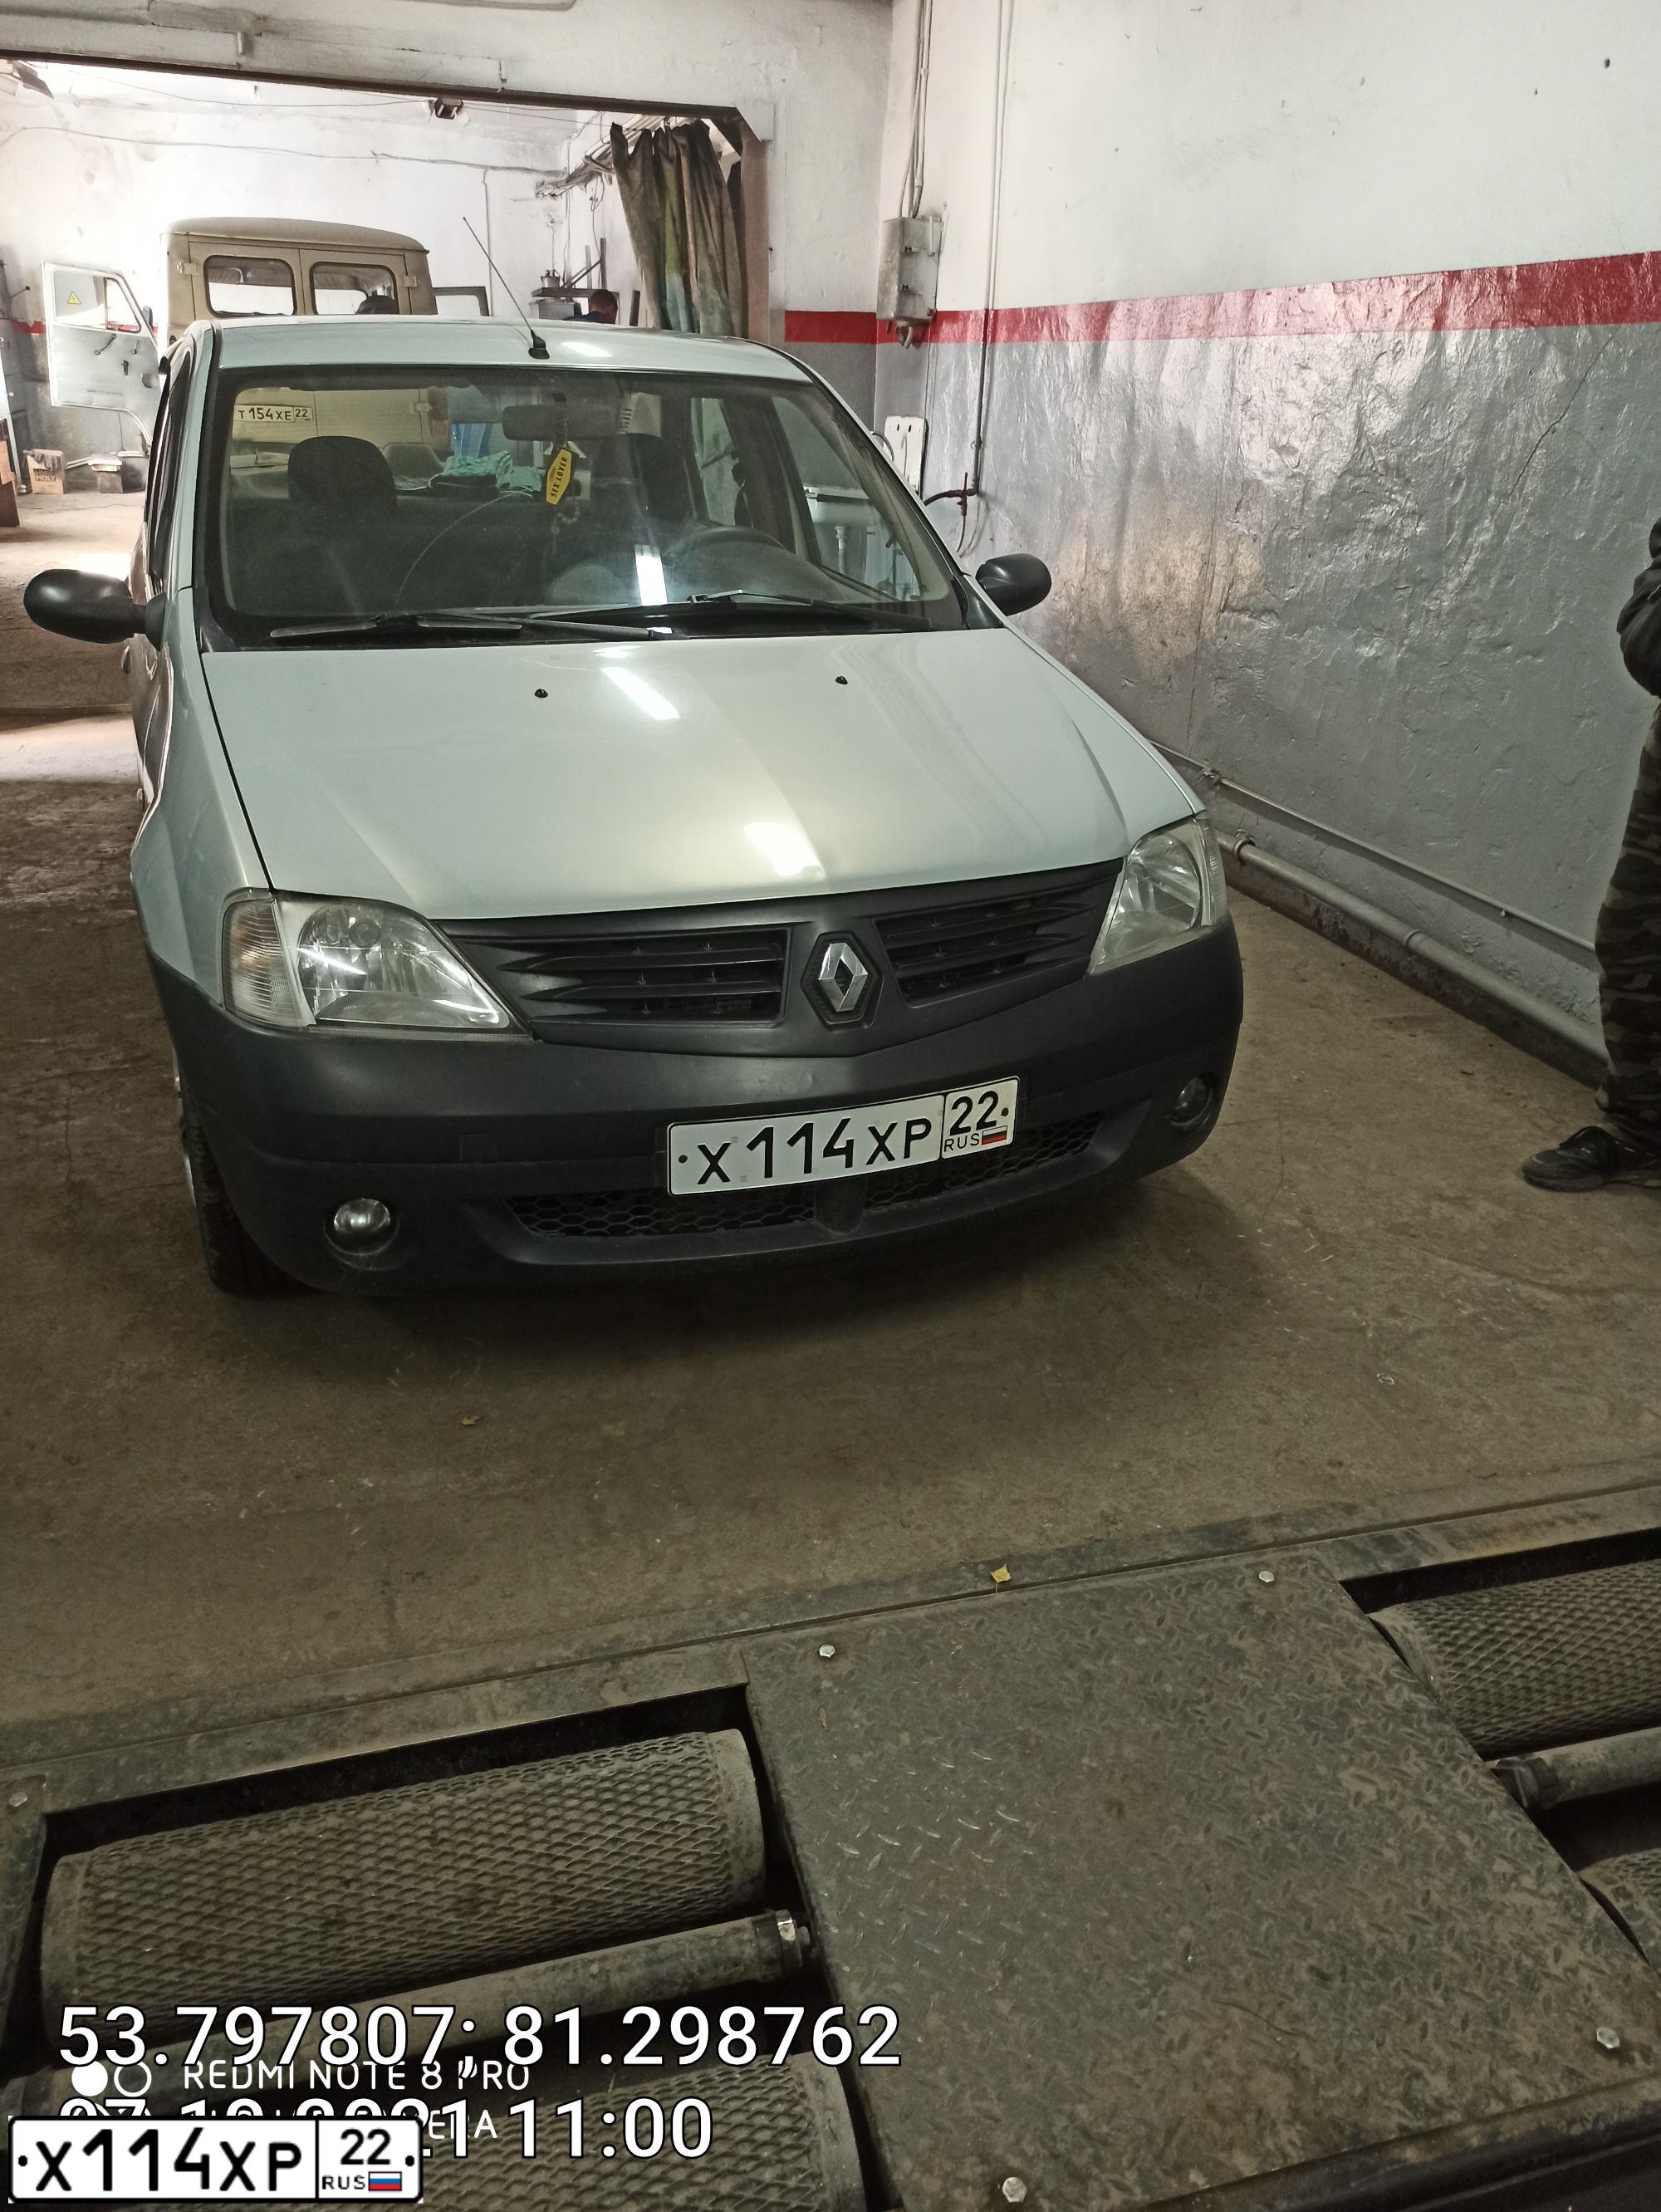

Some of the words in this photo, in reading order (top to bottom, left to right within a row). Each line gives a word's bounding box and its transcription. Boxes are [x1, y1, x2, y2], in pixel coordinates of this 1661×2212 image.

[238, 407, 292, 420] Т154ХЕ
[295, 408, 308, 417] 22
[551, 483, 560, 498] SEX
[556, 457, 568, 482] LOVER
[697, 1117, 932, 1184] Х114ХР
[949, 1090, 999, 1135] 22
[943, 1132, 981, 1153] RUS
